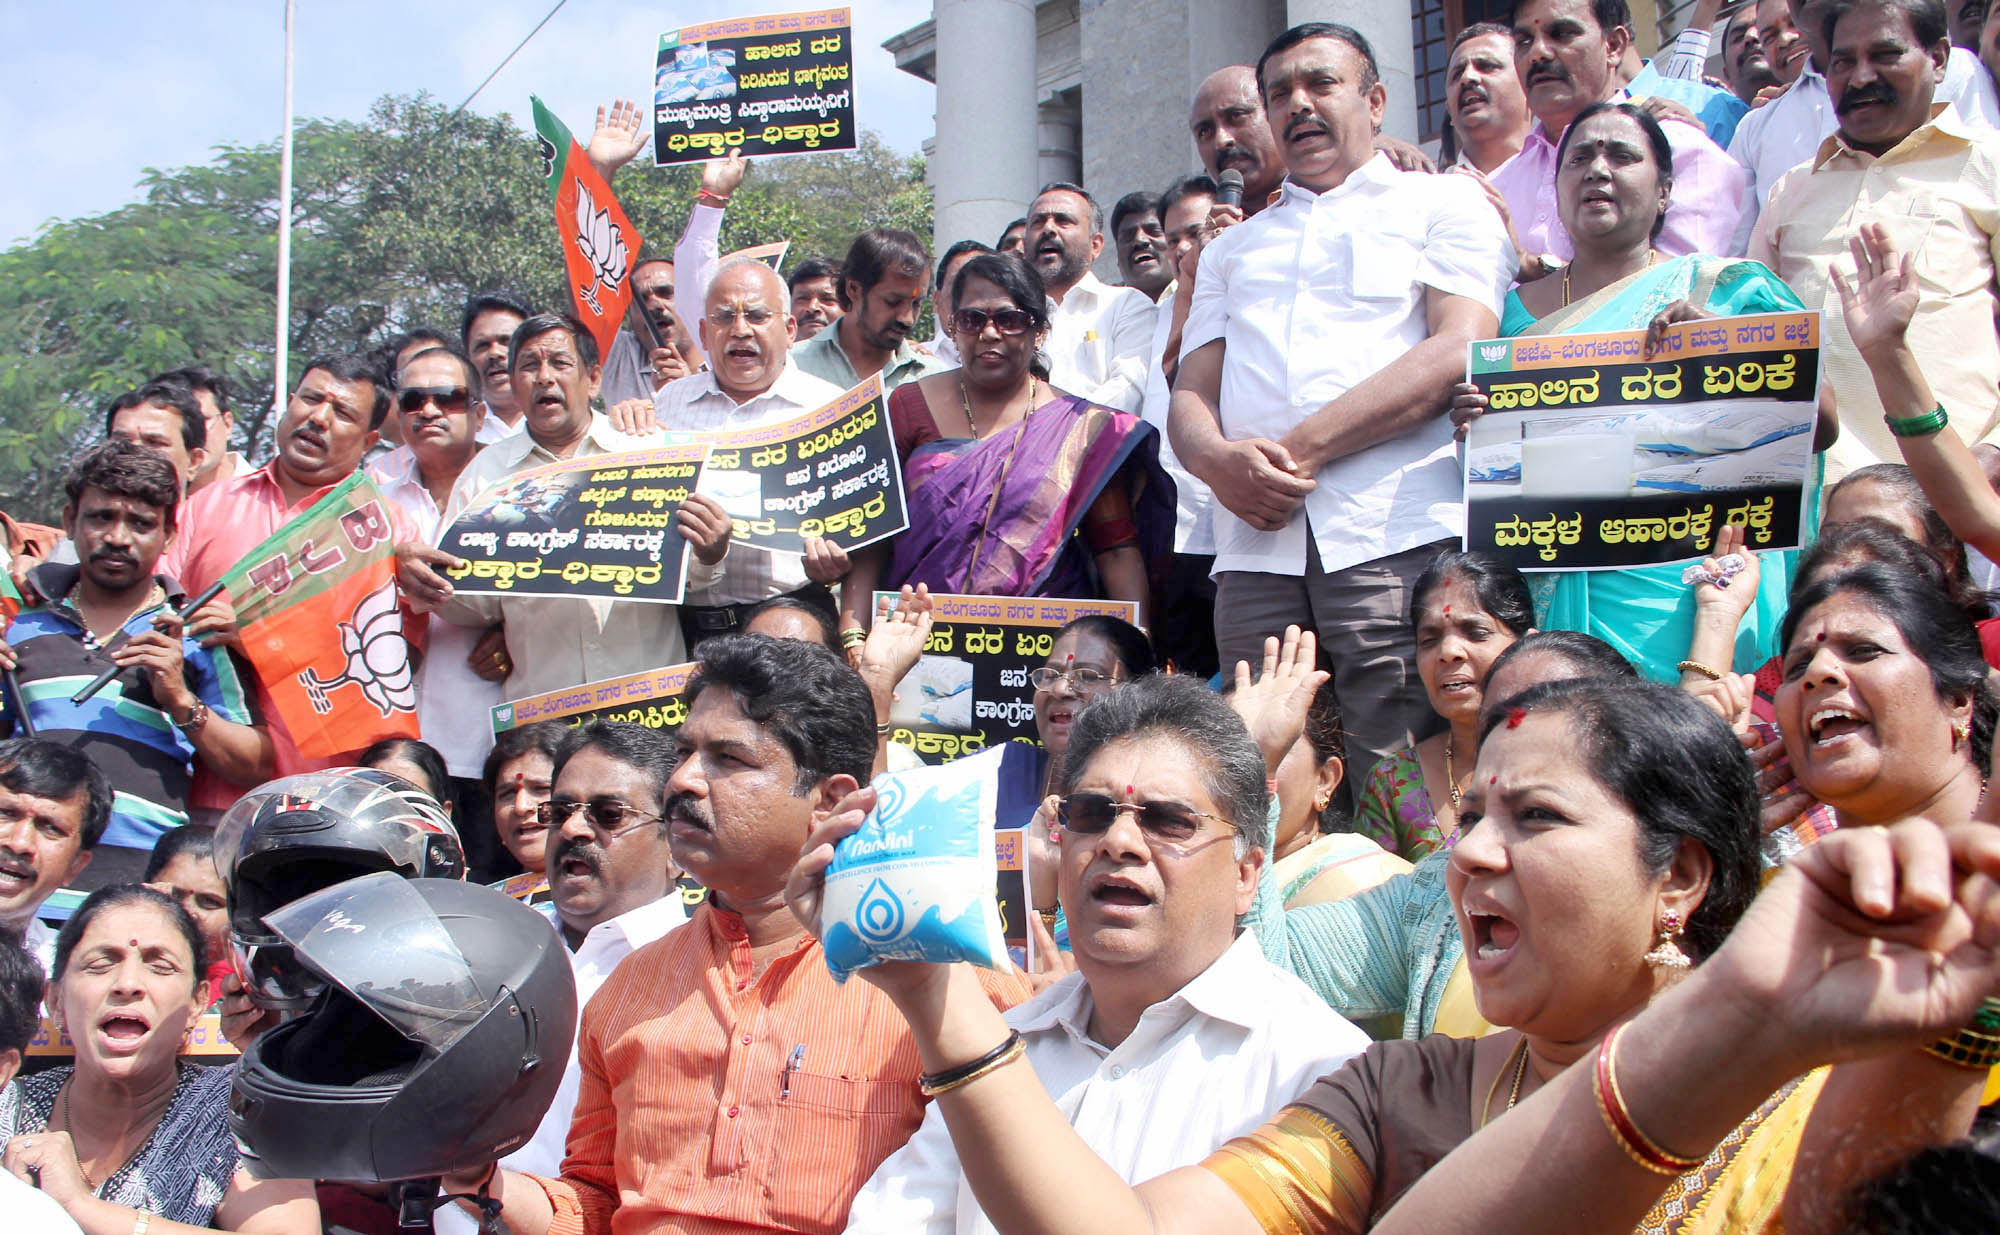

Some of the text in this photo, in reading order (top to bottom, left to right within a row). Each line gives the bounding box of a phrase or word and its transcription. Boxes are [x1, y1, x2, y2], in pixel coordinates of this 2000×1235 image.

[744, 34, 841, 61] ಹಾಲಿನ ದರ
[739, 62, 849, 90] ಏರಿಸಿರುವ ಭಾಗ್ಯವಂತ
[657, 102, 732, 129] ಮುಖ್ಯಮಂತ್ರಿ
[1690, 326, 1729, 353] ಮತ್ತು
[1736, 321, 1776, 344] ನಗರ
[1784, 317, 1811, 347] ಜಿಲ್ಲೆ
[1489, 354, 1797, 410] ಹಾಲಿನ ದರ ಏರಿಕೆ
[751, 443, 788, 468] ದರ
[797, 403, 878, 460] ಏರಿಸಿರುವ
[763, 457, 890, 515] ಕಾಂಗ್ರೆಸ್ ಸರ್ಕಾರಕ್ಕೆ
[785, 464, 811, 487] ಜನ
[458, 527, 666, 562] ರಾಜ್ಯ ಕಾಂಗ್ರೆಸ್ ಸರ್ಕಾರಕ್ಕೆ
[1494, 511, 1583, 561] ಮಕ್ಕಳ
[1600, 504, 1715, 550] ಆಹಾರಕ್ಕೆ
[1007, 605, 1034, 619] ನಗರ
[1041, 607, 1068, 626] ಮತ್ತು
[965, 626, 1004, 655] ದರ
[1015, 632, 1054, 657] ಏರಿ
[1000, 664, 1028, 689] ಜನ
[596, 685, 621, 702] ನಗರ
